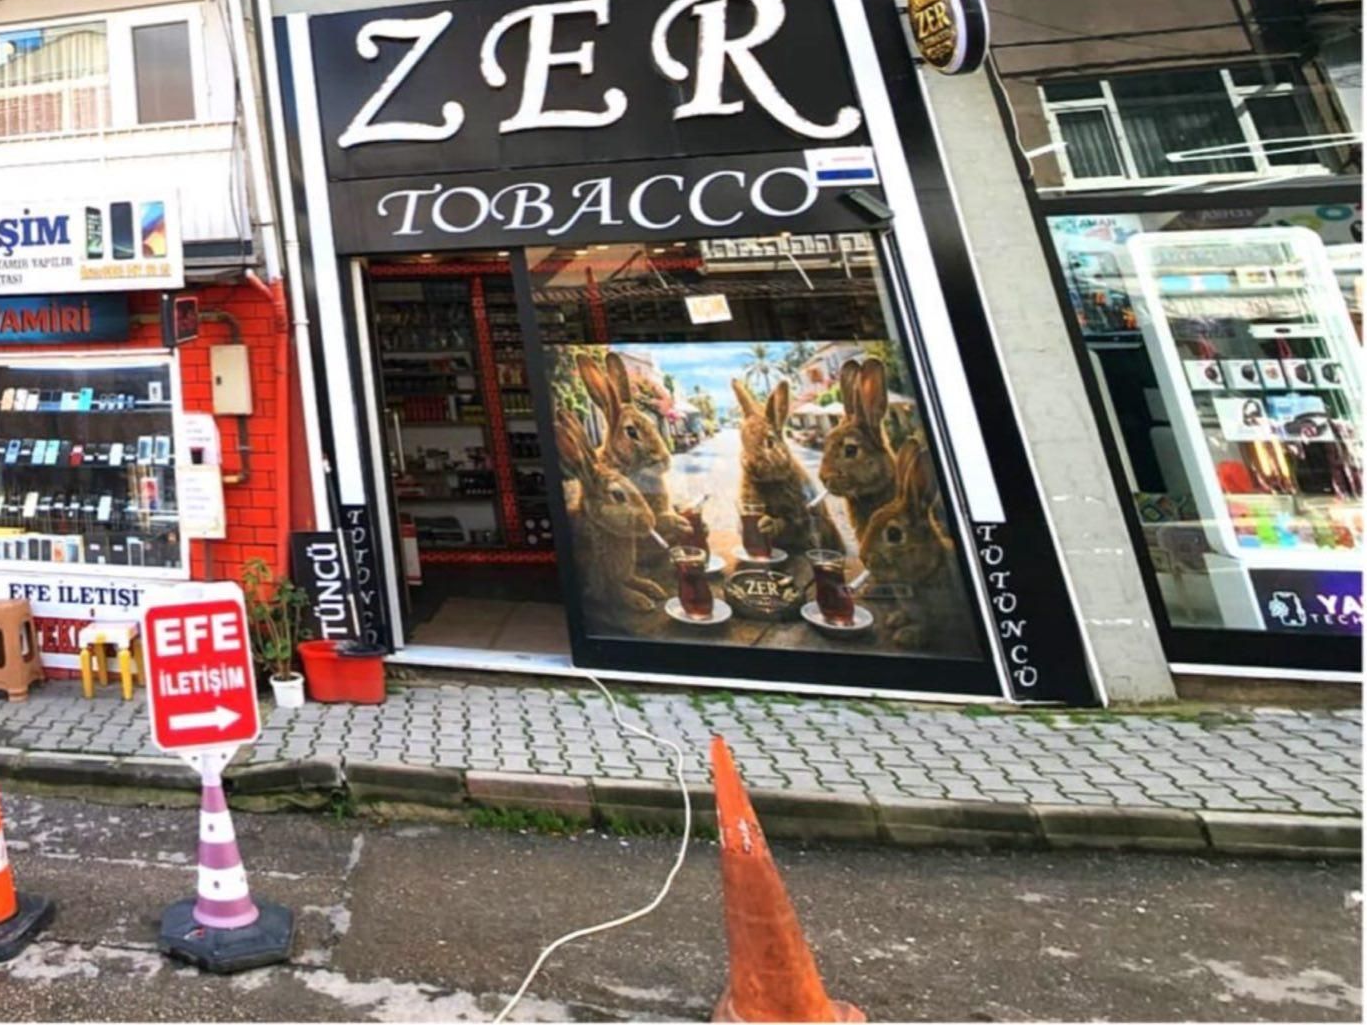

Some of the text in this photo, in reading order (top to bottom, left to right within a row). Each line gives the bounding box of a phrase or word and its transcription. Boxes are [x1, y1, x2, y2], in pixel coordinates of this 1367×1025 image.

[915, 0, 952, 39] ZER
[377, 166, 819, 236] TOBACCO
[8, 579, 145, 610] EFE İLETİŞİ
[306, 542, 349, 640] TÜNCÜ
[745, 579, 780, 596] ZER
[1315, 593, 1363, 616] YA
[154, 612, 241, 657] EFE
[159, 663, 246, 699] İLETİŞİM
